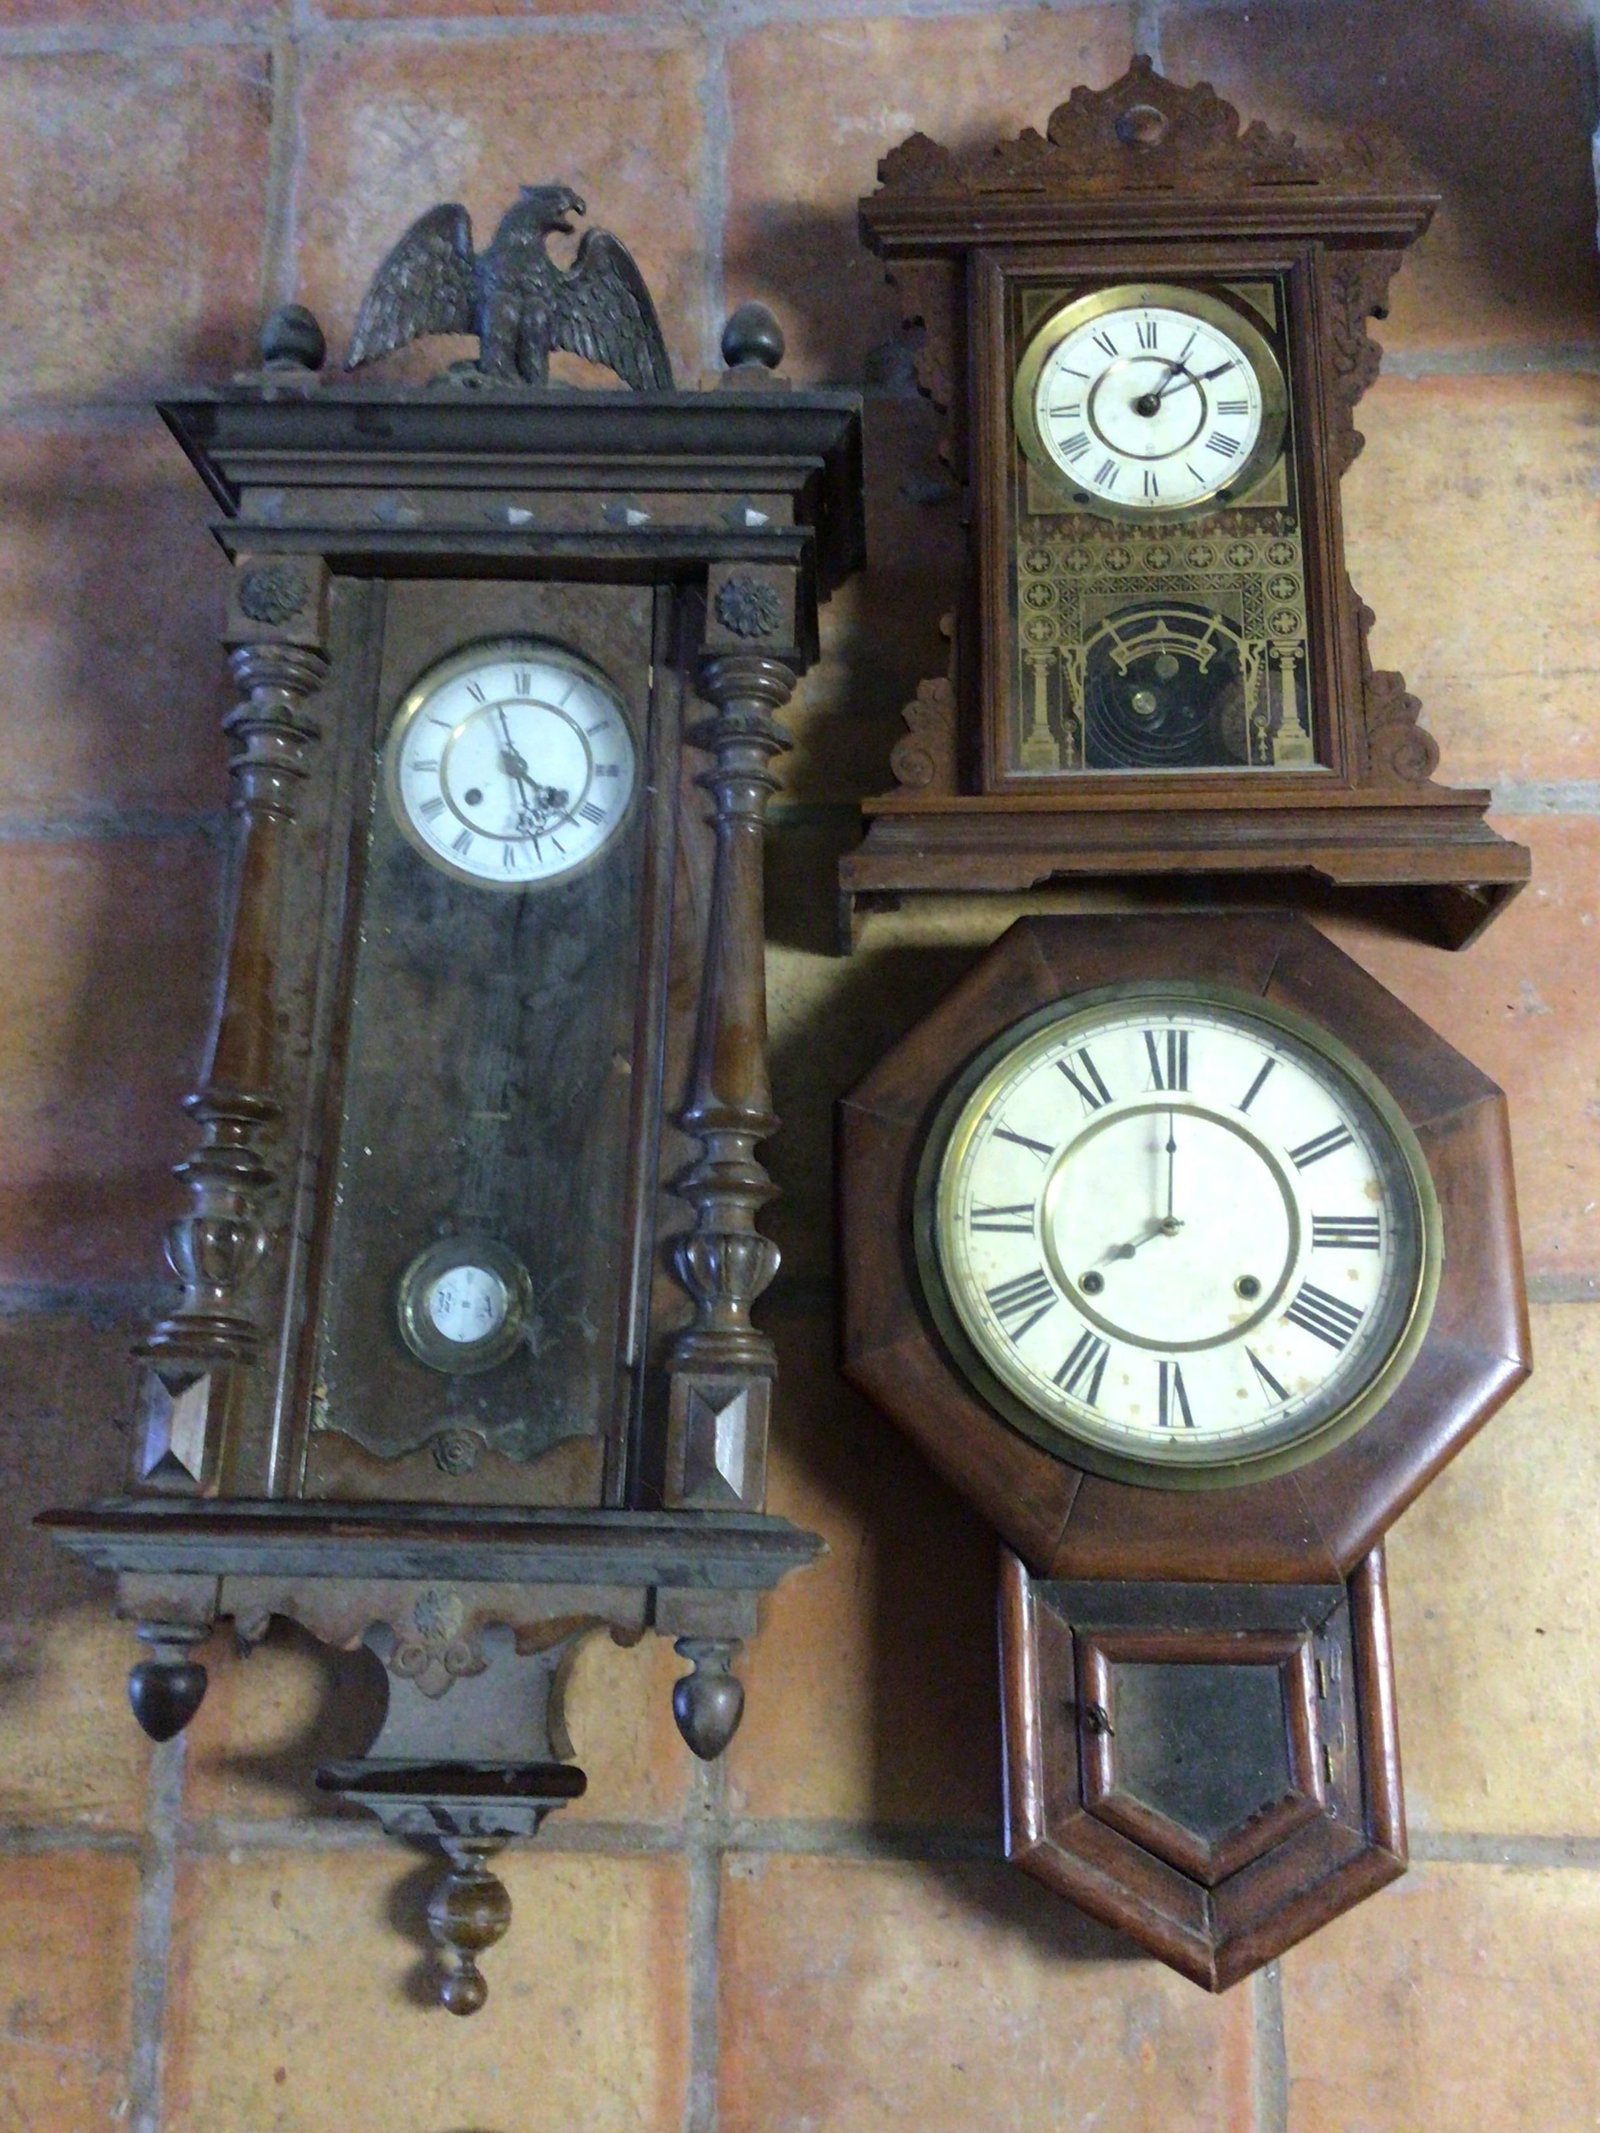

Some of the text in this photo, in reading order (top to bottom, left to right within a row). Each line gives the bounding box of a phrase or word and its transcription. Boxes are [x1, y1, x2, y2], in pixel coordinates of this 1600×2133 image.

[1216, 399, 1249, 416] III
[1052, 1047, 1117, 1116] XI
[1143, 1029, 1196, 1093] XII
[1234, 1054, 1285, 1116] I
[990, 1116, 1057, 1172] X
[1284, 1116, 1362, 1174] II
[970, 1193, 1037, 1247] IX
[1311, 1209, 1382, 1257] III
[984, 1263, 1058, 1347] VIII
[1283, 1278, 1367, 1357] IIII
[1049, 1324, 1111, 1409] VII
[1151, 1359, 1201, 1429] VI
[1244, 1344, 1298, 1409] V
